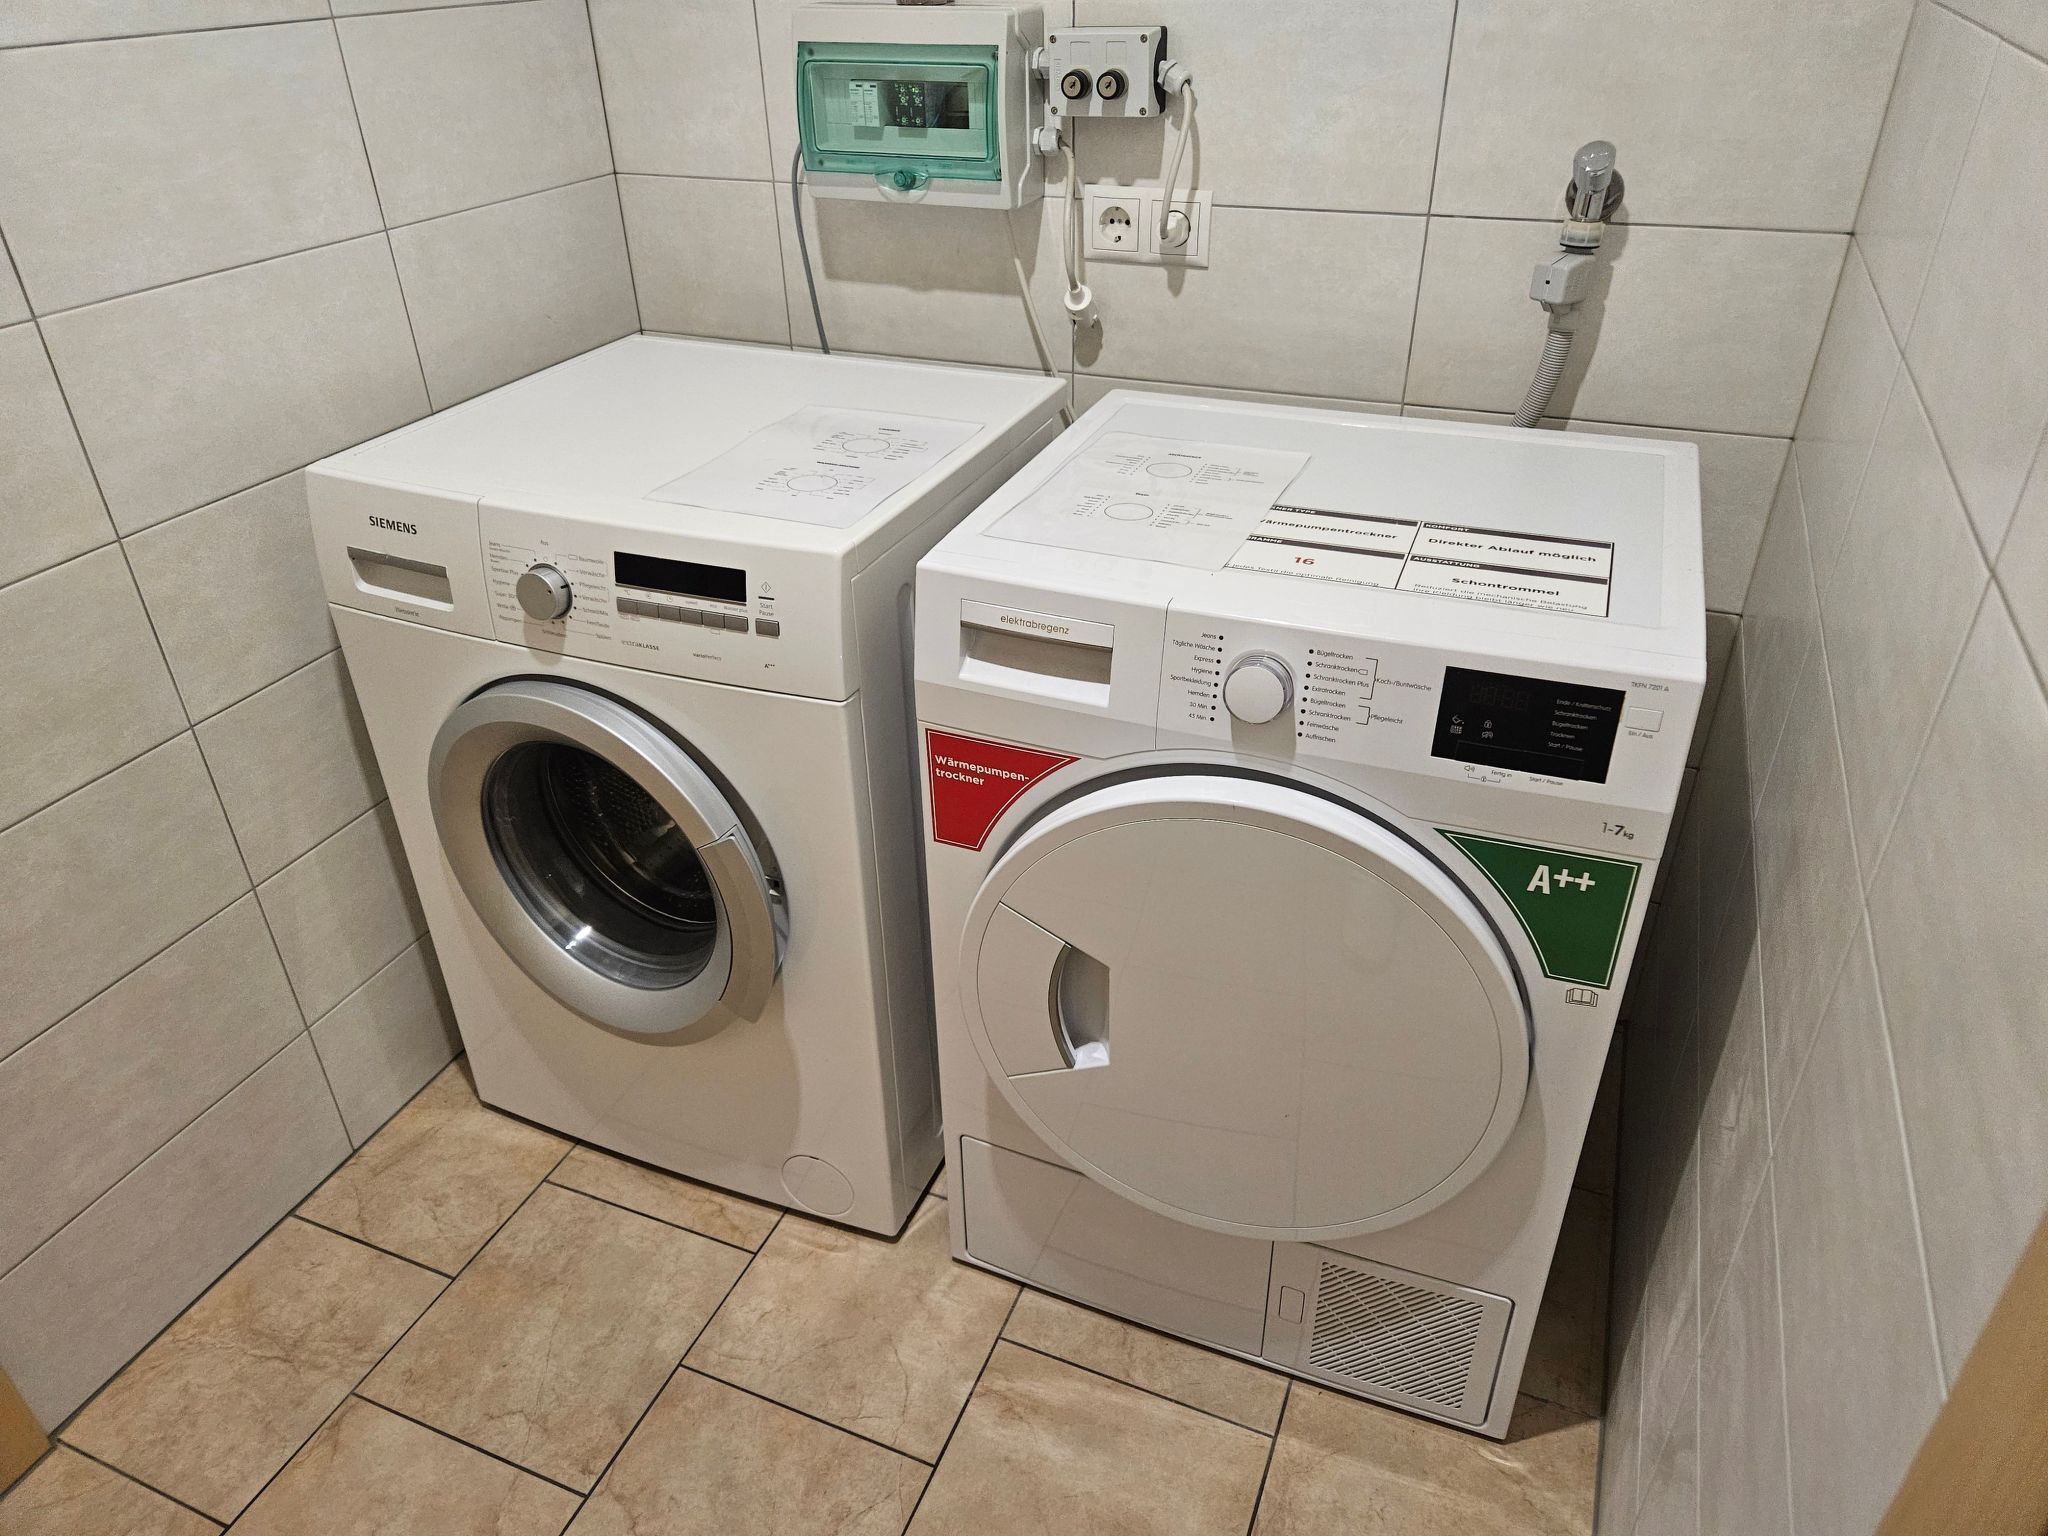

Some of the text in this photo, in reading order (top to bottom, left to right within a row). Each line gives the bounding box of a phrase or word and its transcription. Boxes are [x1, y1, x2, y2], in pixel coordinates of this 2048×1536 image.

[369, 516, 417, 535] SIEMENS
[1426, 523, 1469, 532] KOMFORT
[1429, 538, 1596, 562] Direkter Ablauf möglich
[1294, 557, 1316, 566] 16
[1414, 556, 1480, 569] AUSSTATTUNG
[1451, 578, 1559, 596] Schontrommel
[760, 602, 773, 610] Start
[1001, 615, 1070, 635] elektrabregenz
[1201, 632, 1217, 640] Jeans
[1172, 639, 1216, 651] Tägliche Wäsche
[1194, 655, 1214, 664] Express
[1317, 650, 1354, 660] Bügeltrocken
[1192, 667, 1213, 676] Hygiene
[1315, 662, 1358, 674] Schranktrocken
[1170, 674, 1211, 687] Sportbekleidung
[1313, 674, 1370, 688] Schranktrocken Plus
[1377, 678, 1432, 691] Koch-/Buntwäsche
[1188, 690, 1210, 698] Hemden
[1312, 686, 1345, 696] Extratrocken
[1310, 698, 1346, 709] Bügeltrocken
[1309, 710, 1351, 722] Schranktrocken
[1370, 714, 1404, 725] Pflegeleicht
[1307, 721, 1339, 732] Feinwäsche
[1305, 733, 1336, 743] Auffrischen
[1641, 732, 1653, 740] Aus
[935, 754, 1030, 781] Wärmepumpen-
[936, 769, 985, 786] trockner
[1491, 770, 1507, 778] Fertig
[1527, 864, 1596, 895] A++
